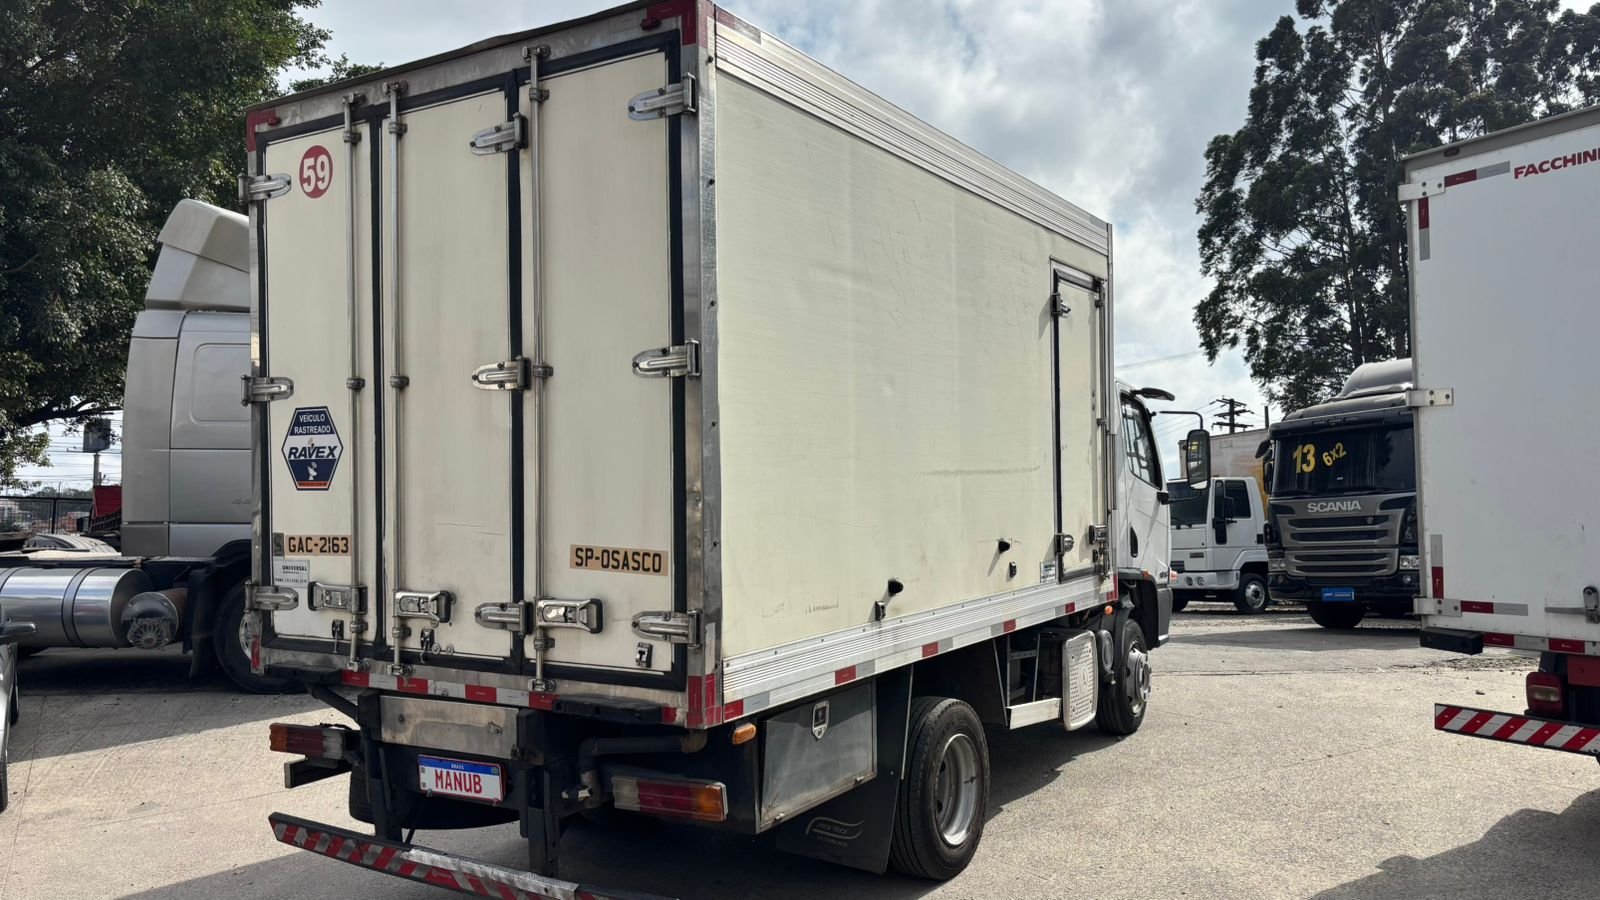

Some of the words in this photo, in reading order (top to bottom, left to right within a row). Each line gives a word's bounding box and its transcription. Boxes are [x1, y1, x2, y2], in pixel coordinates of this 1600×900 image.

[302, 154, 330, 193] 59
[299, 412, 325, 423] VEÍCULO
[294, 425, 331, 434] RASTREADO
[288, 445, 338, 459] RAVEX
[1293, 443, 1316, 474] 13
[1307, 500, 1362, 513] SCANIA
[288, 536, 349, 554] GAC-2163
[575, 547, 662, 573] SP-OSASCO
[434, 768, 483, 794] MANUB
